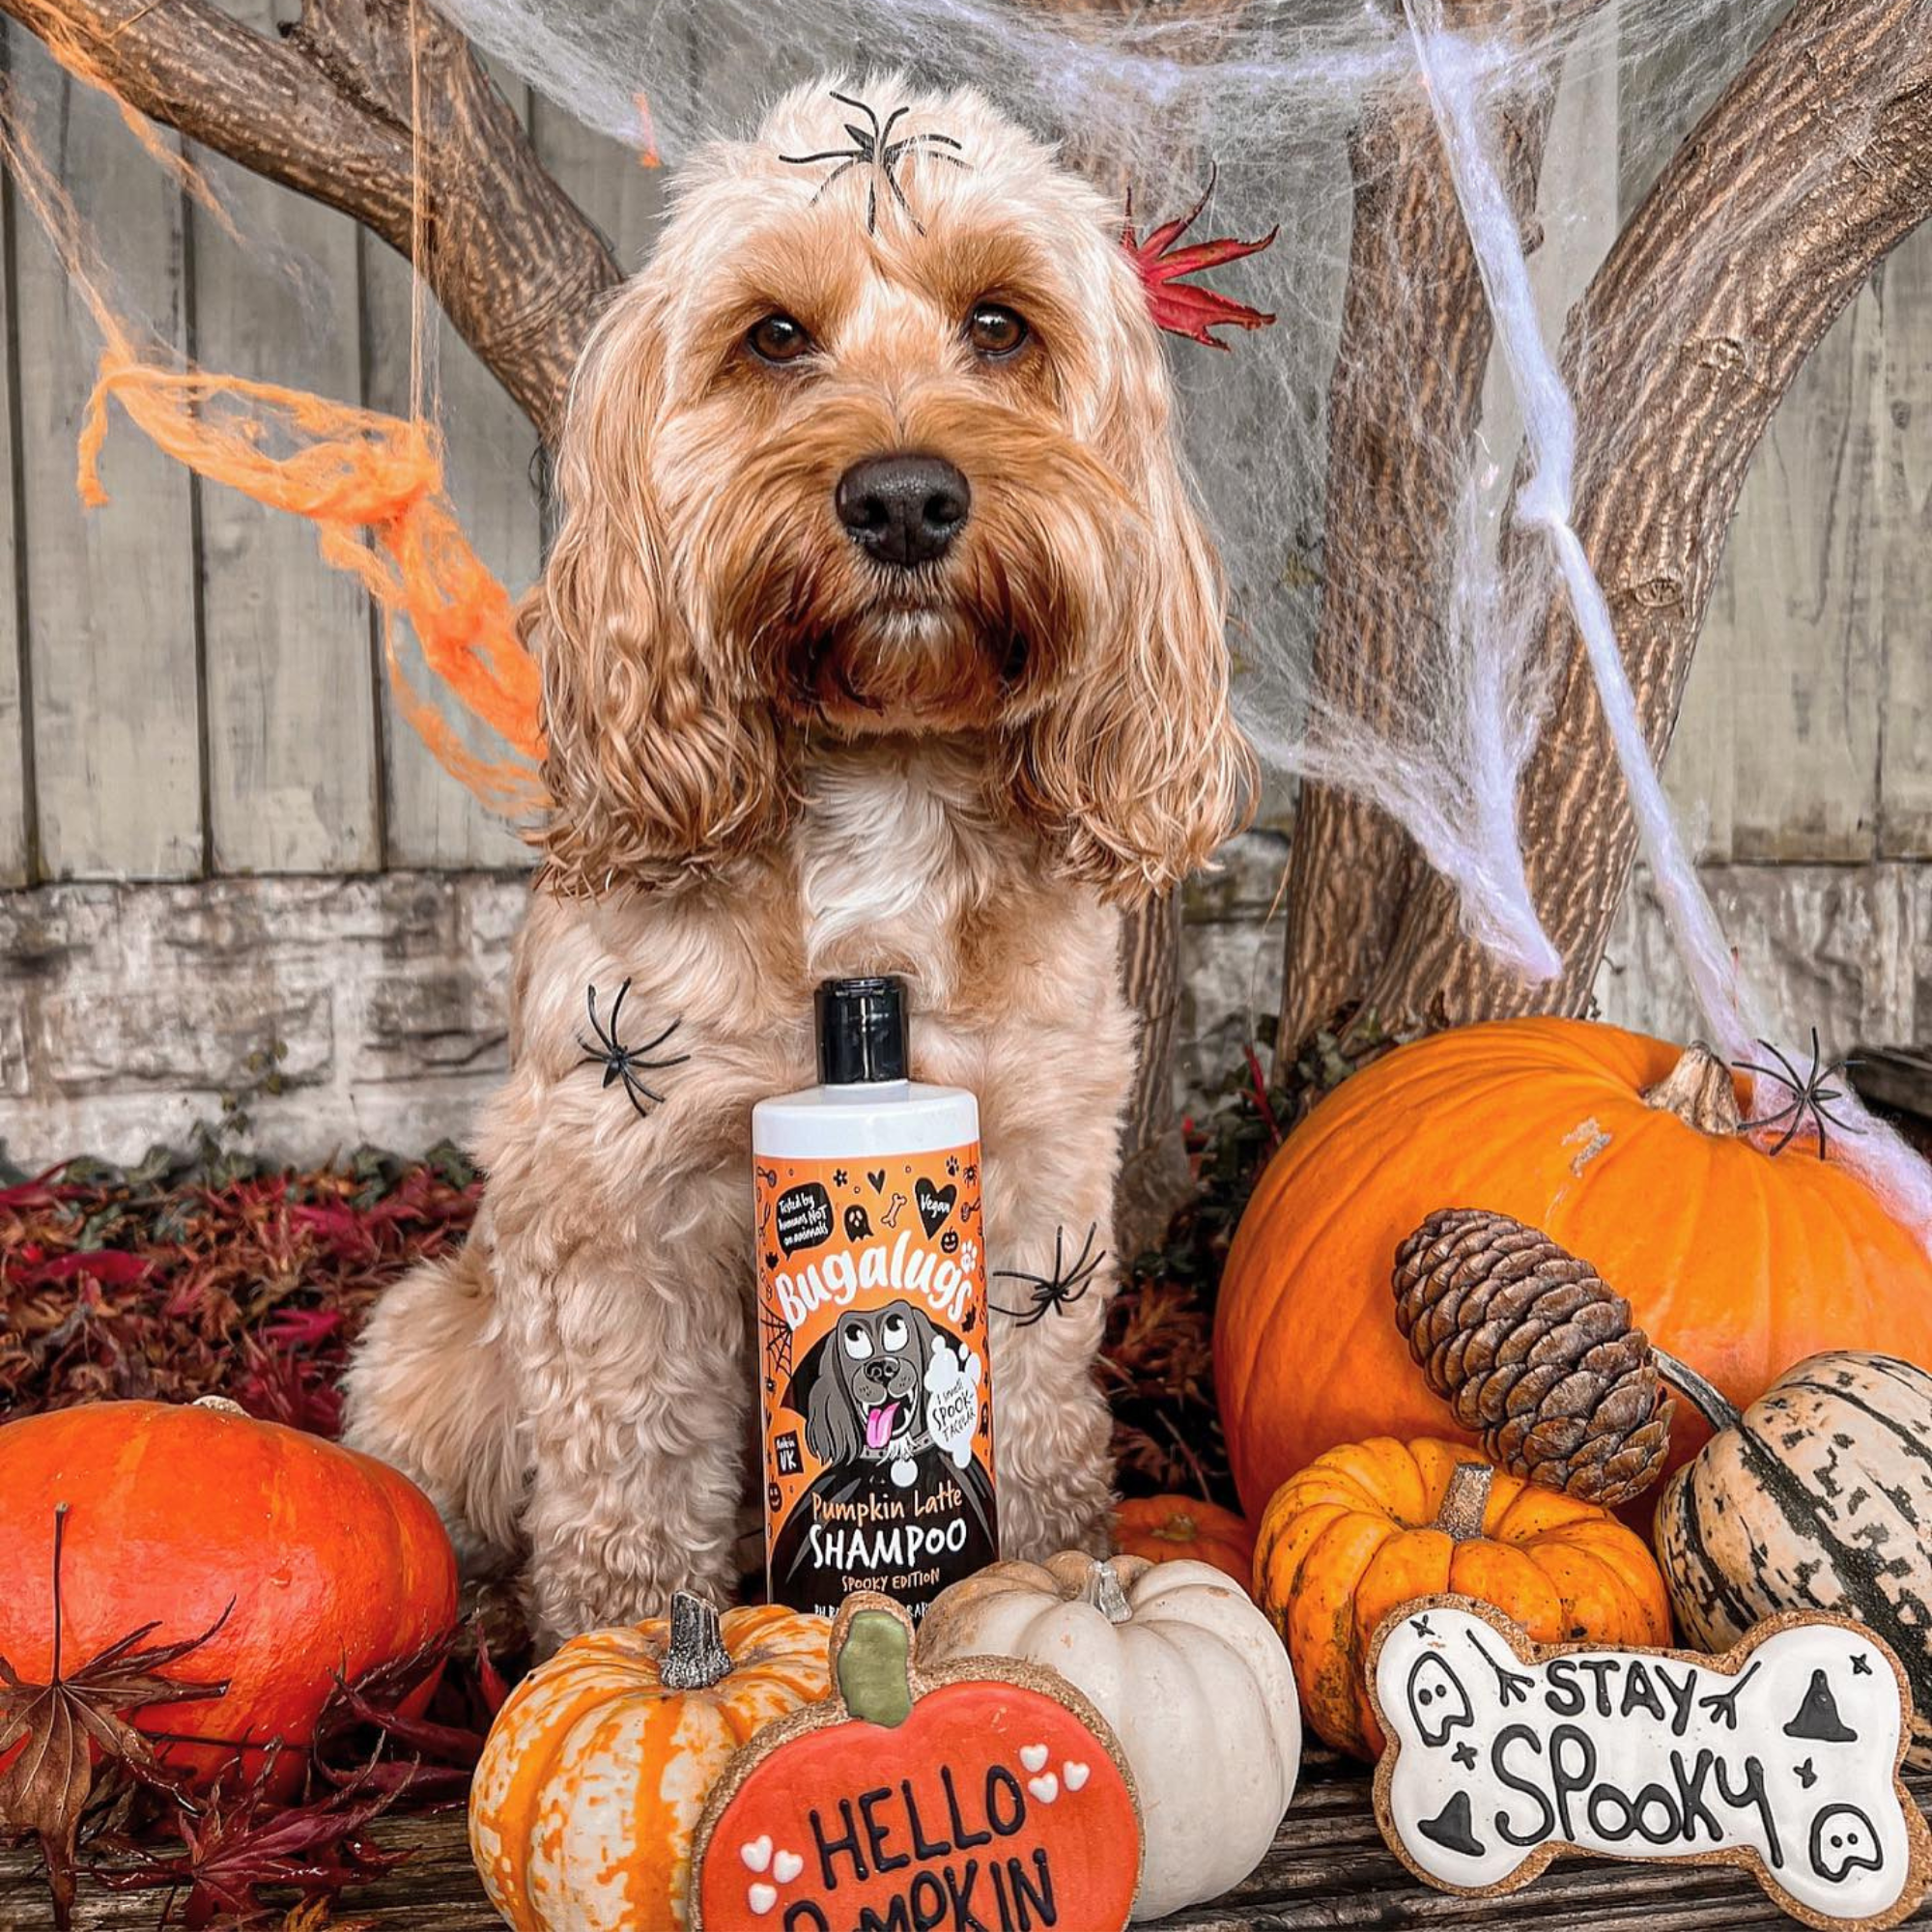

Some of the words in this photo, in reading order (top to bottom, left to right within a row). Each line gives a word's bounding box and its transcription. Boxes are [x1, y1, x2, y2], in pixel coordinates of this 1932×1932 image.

[779, 1194, 802, 1214] Tested
[801, 1192, 815, 1210] by
[808, 1204, 828, 1226] NOT
[920, 1194, 951, 1219] Vegan
[793, 1221, 829, 1243] animals
[775, 1230, 972, 1331] Bugalugs
[780, 1449, 797, 1471] UK
[811, 1492, 905, 1528] Pumpkin
[914, 1480, 963, 1513] Latte
[809, 1518, 967, 1572] SHAMPOO
[841, 1575, 889, 1592] SPOOKY
[892, 1567, 940, 1590] EDITION
[1545, 1660, 1697, 1736] STAY
[809, 1765, 1026, 1890] HELLO
[782, 1847, 1058, 1932] MPKIN
